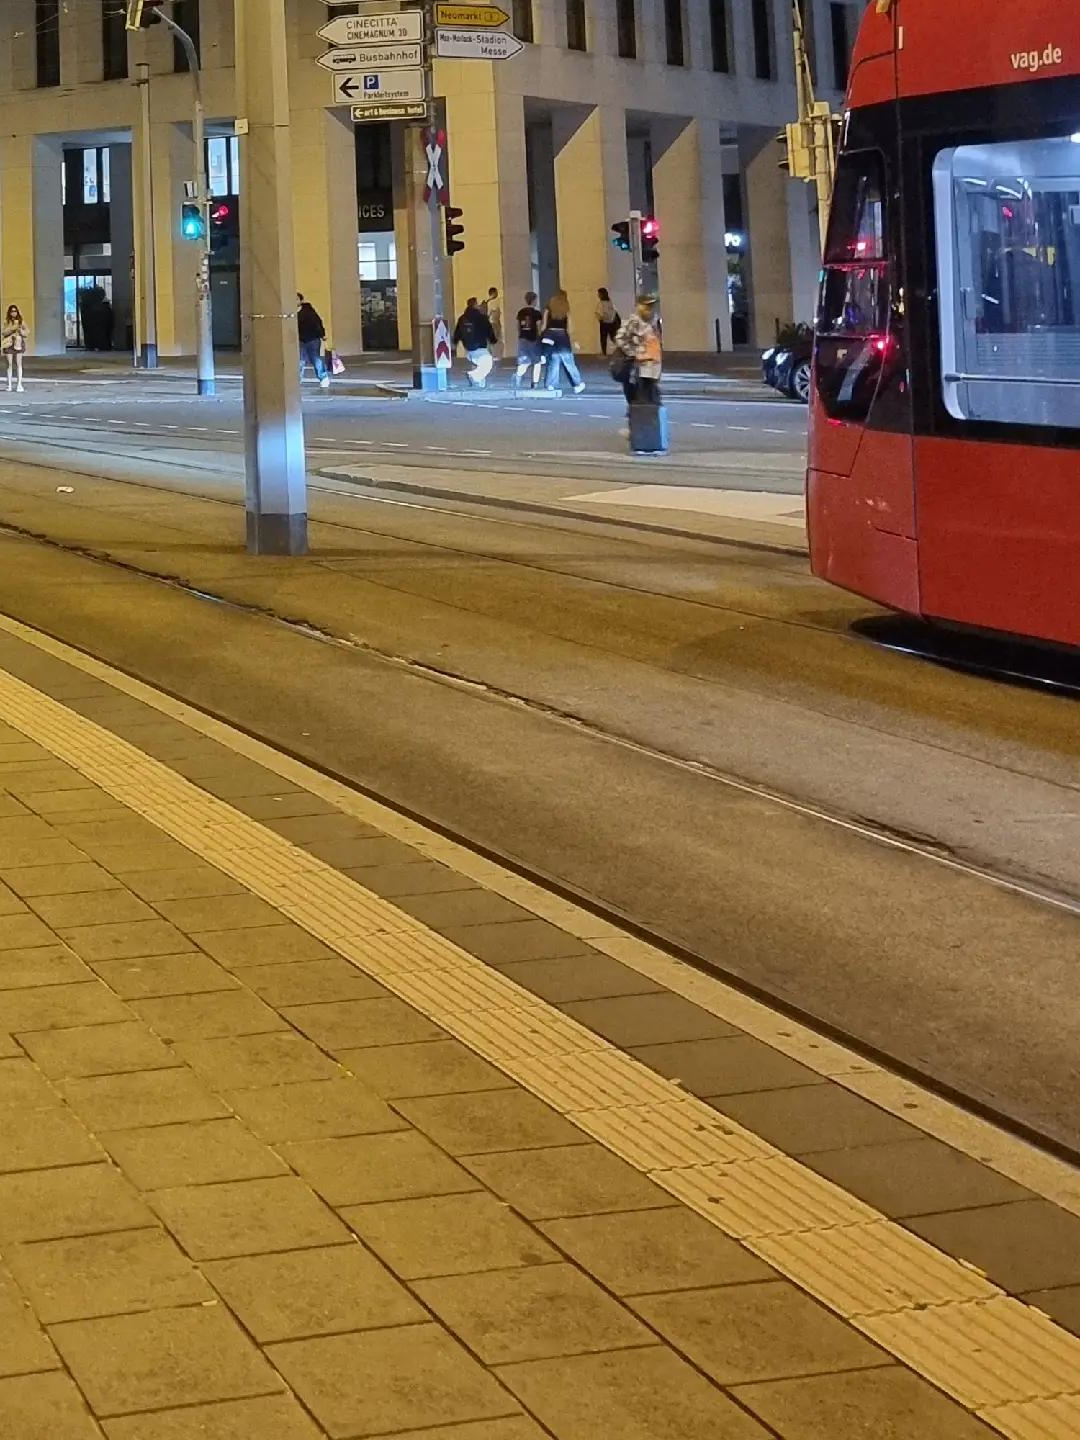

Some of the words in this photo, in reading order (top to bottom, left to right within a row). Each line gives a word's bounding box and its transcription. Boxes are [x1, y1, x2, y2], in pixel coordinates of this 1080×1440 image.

[440, 10, 482, 20] Neumarkt
[347, 29, 395, 40] CINEMAGNUM
[360, 50, 418, 62] Busbahnhof
[481, 46, 508, 56] Messe
[1011, 42, 1062, 72] vag.de
